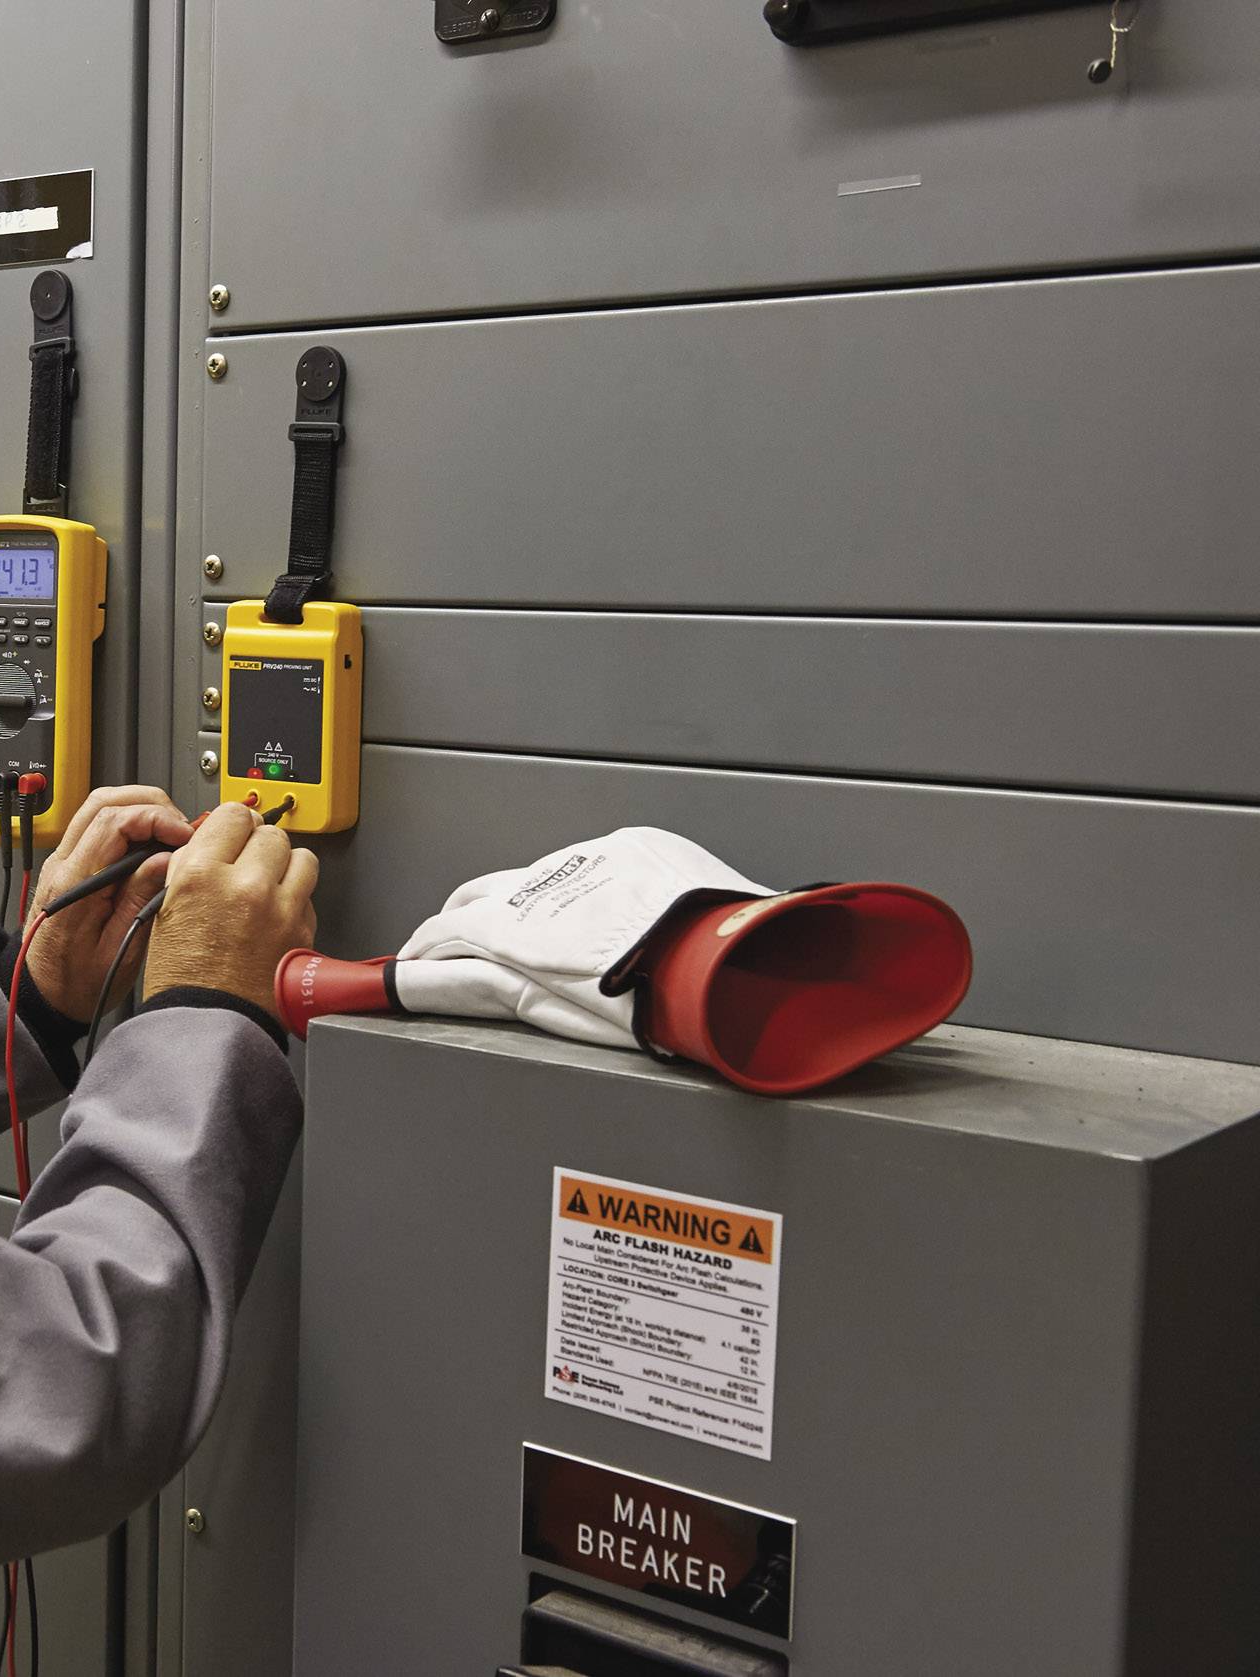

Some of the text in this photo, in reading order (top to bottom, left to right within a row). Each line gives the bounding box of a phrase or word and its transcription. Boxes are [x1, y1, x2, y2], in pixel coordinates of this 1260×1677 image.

[262, 663, 283, 671] PRV240
[597, 1192, 730, 1246] WARNING
[563, 1236, 574, 1246] No
[575, 1239, 594, 1250] Local
[597, 1244, 614, 1255] Main
[616, 1248, 659, 1265] Considered
[660, 1259, 673, 1269] For
[676, 1262, 689, 1272] Arc
[691, 1266, 712, 1278] Flash
[593, 1228, 732, 1270] ARC FLASH HAZARD
[594, 1254, 629, 1270] Upstream
[631, 1262, 667, 1278] Protective
[670, 1271, 696, 1285] Device
[562, 1280, 594, 1294] Arc-Flash
[596, 1288, 629, 1304] Boundary:
[562, 1291, 585, 1302] Hazard
[606, 1273, 628, 1286] CORE
[637, 1280, 678, 1298] Switchgear
[740, 1306, 754, 1316] 480
[755, 1309, 762, 1318] V
[561, 1310, 585, 1322] Limited
[587, 1316, 617, 1330] Approach
[620, 1324, 645, 1338] (Shock)
[562, 1300, 587, 1312] Incident
[589, 1306, 612, 1320] Energy
[644, 1322, 671, 1335] working
[560, 1336, 575, 1346] Date
[561, 1319, 594, 1334] Restricted
[595, 1328, 628, 1343] Approach
[630, 1337, 655, 1350] (Shock)
[560, 1346, 593, 1361] Standards
[642, 1367, 663, 1379] NFPA
[665, 1373, 677, 1383] 70E
[704, 1384, 717, 1394] and
[719, 1388, 736, 1399] IEEE
[648, 1395, 663, 1406] PSE
[665, 1400, 690, 1414] Project
[614, 1493, 691, 1545] MAIN
[578, 1523, 726, 1599] BREAKER
